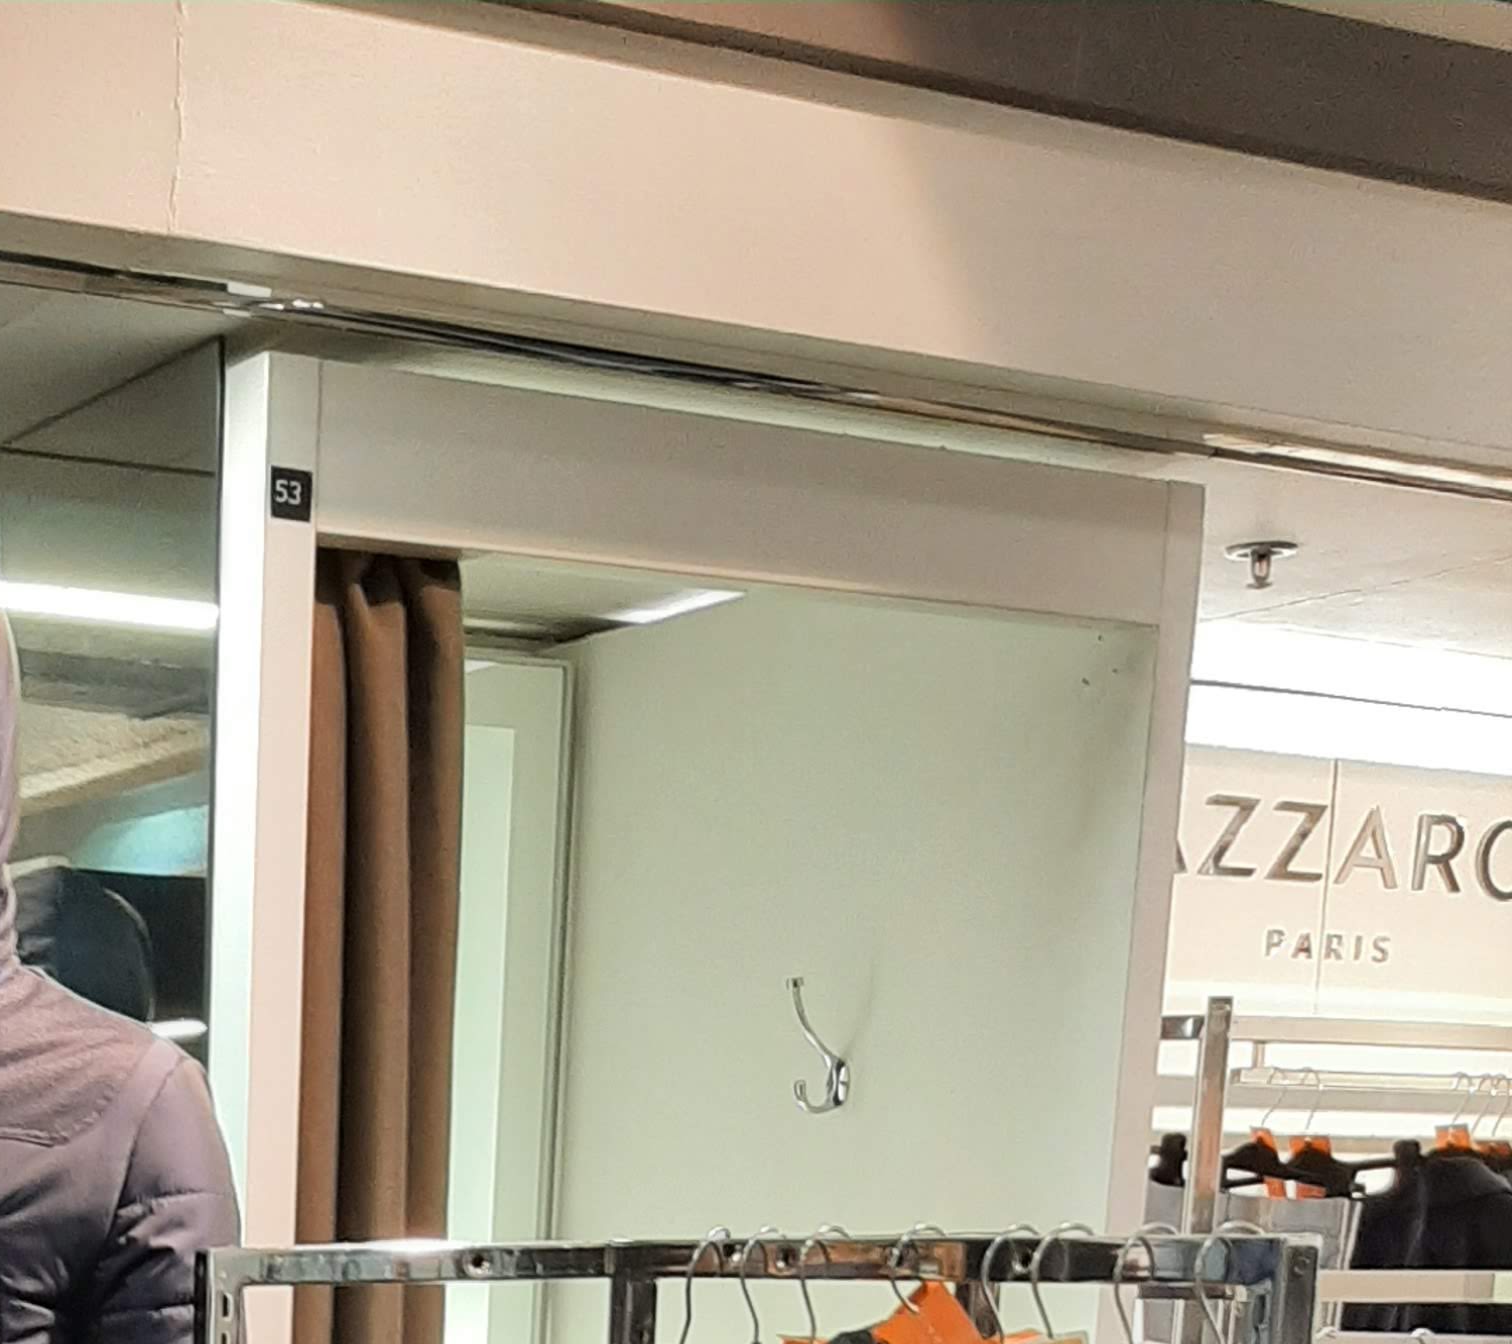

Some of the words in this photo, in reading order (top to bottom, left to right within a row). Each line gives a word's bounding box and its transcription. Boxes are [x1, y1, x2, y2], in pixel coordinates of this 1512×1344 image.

[274, 479, 302, 505] 53
[1175, 793, 1512, 902] ZZARO
[1264, 928, 1391, 963] PARIS
